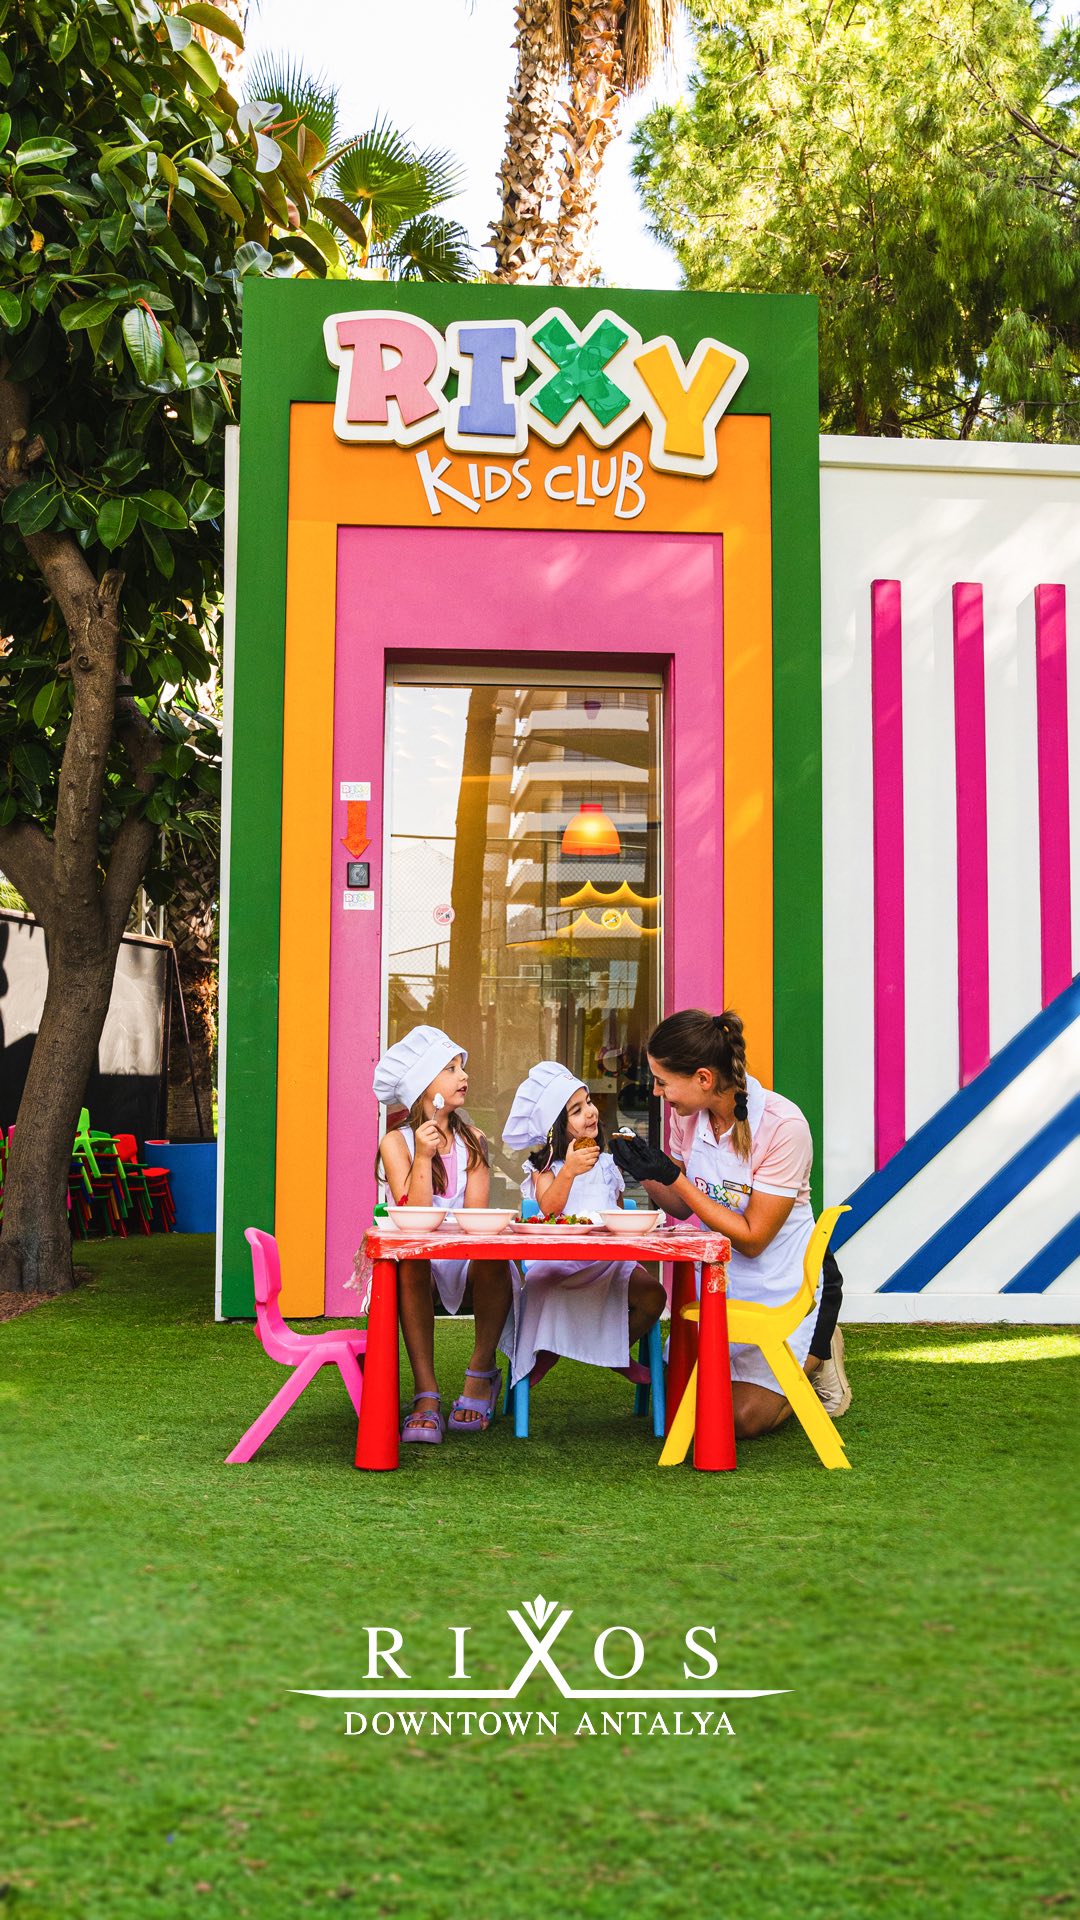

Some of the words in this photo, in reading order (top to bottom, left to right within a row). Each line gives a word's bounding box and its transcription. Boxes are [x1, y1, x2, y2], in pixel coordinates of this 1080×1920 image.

[335, 315, 738, 458] RIXY
[415, 450, 532, 516] KIDS
[544, 450, 646, 519] CLUB
